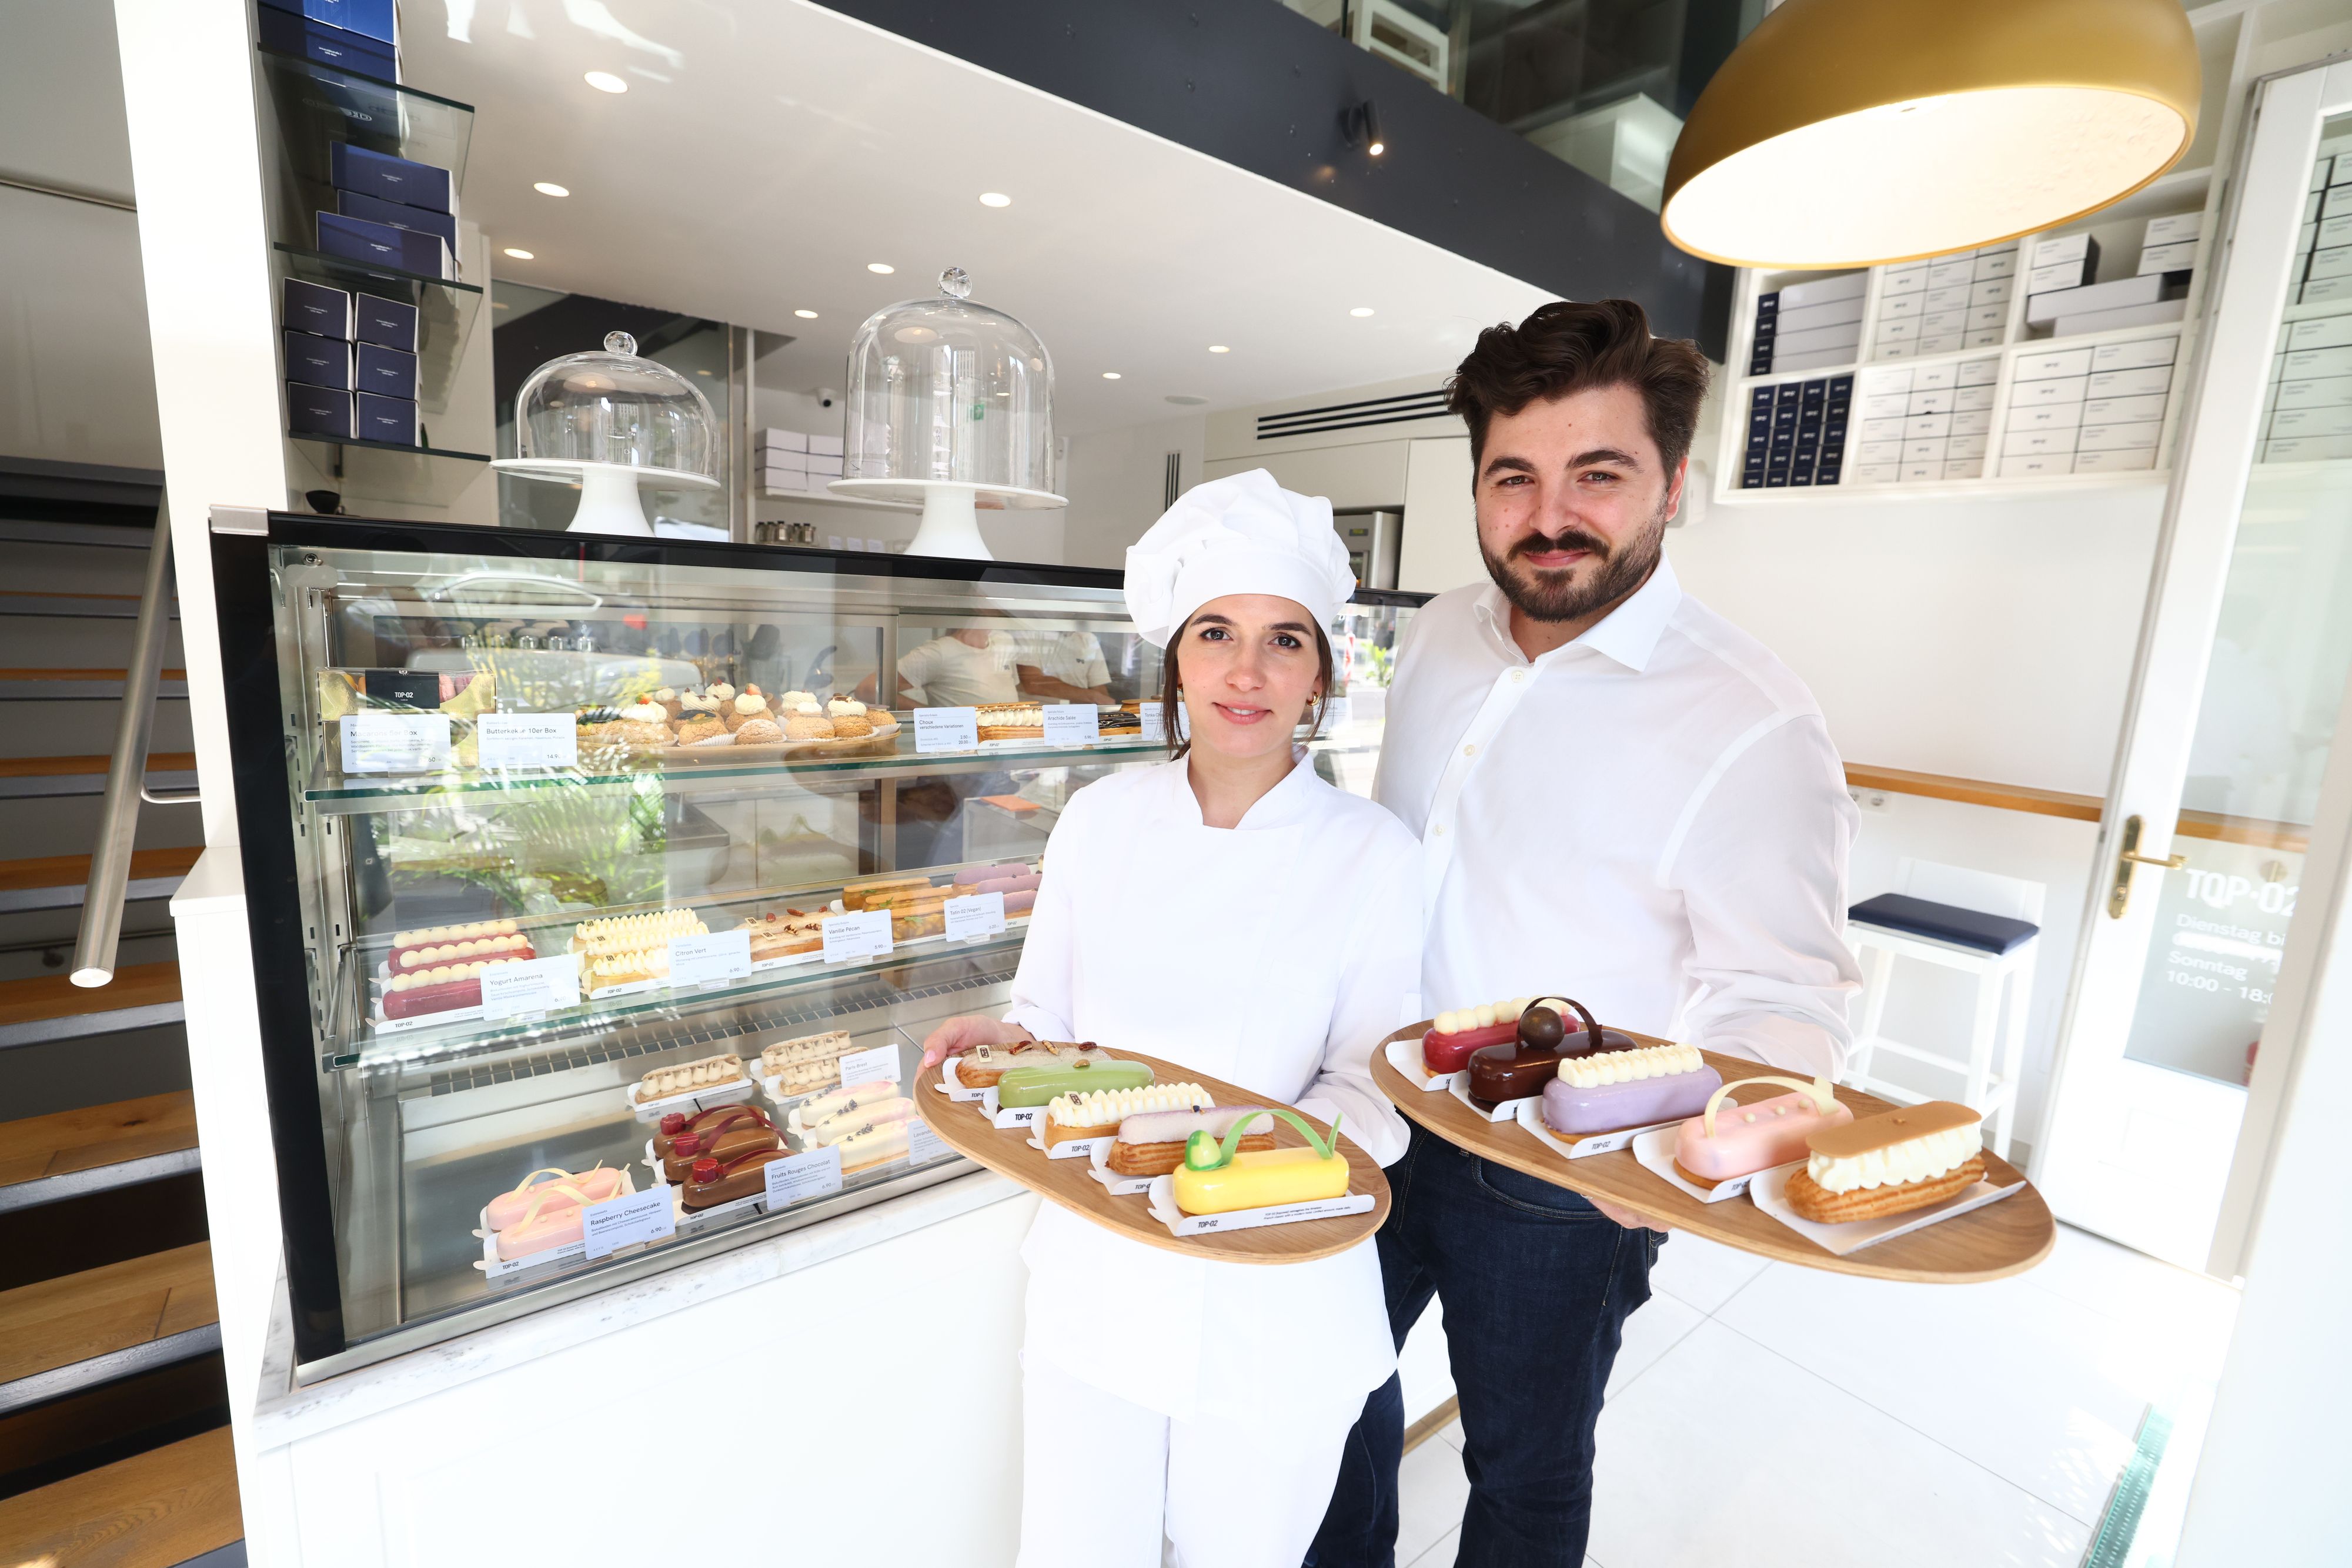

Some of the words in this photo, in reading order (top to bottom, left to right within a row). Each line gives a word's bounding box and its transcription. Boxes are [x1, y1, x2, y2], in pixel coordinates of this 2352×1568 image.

[2176, 913, 2262, 945] Dienstag
[2267, 931, 2286, 947] bi
[513, 974, 543, 982] Amarena
[2167, 950, 2248, 981] Sonntag
[2167, 970, 2219, 992] 10:00
[2239, 986, 2273, 1005] 18:
[787, 1167, 806, 1175] Rouges
[807, 1159, 831, 1169] Chocolat
[590, 1212, 623, 1226] Raspberry
[624, 1202, 660, 1216] Cheesecake
